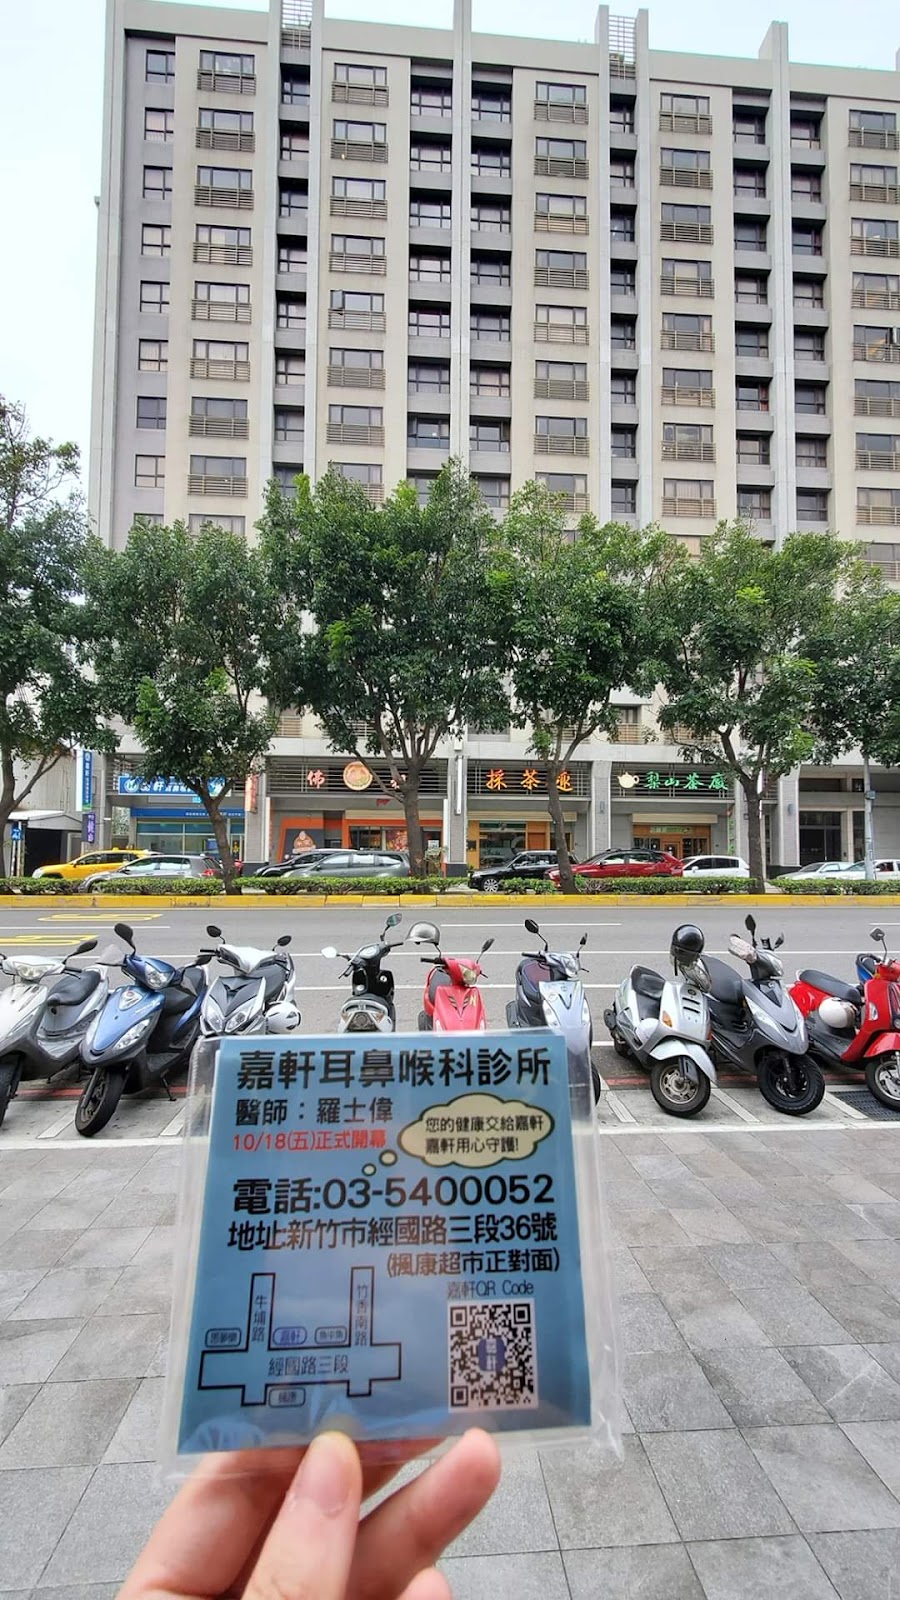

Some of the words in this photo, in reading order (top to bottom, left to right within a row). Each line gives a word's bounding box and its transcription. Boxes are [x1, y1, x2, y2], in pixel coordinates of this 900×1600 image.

[237, 1047, 551, 1090] 嘉軒耳鼻喉科診所
[425, 1115, 544, 1133] 您的健康交給嘉軒
[233, 1129, 387, 1151] 10/18(五)正式開幕
[233, 1175, 555, 1215] 電話:03-5400052
[387, 1248, 560, 1277] (楓康超市正對面)
[502, 1279, 534, 1295] Code
[268, 1354, 348, 1377] 經國路三段
